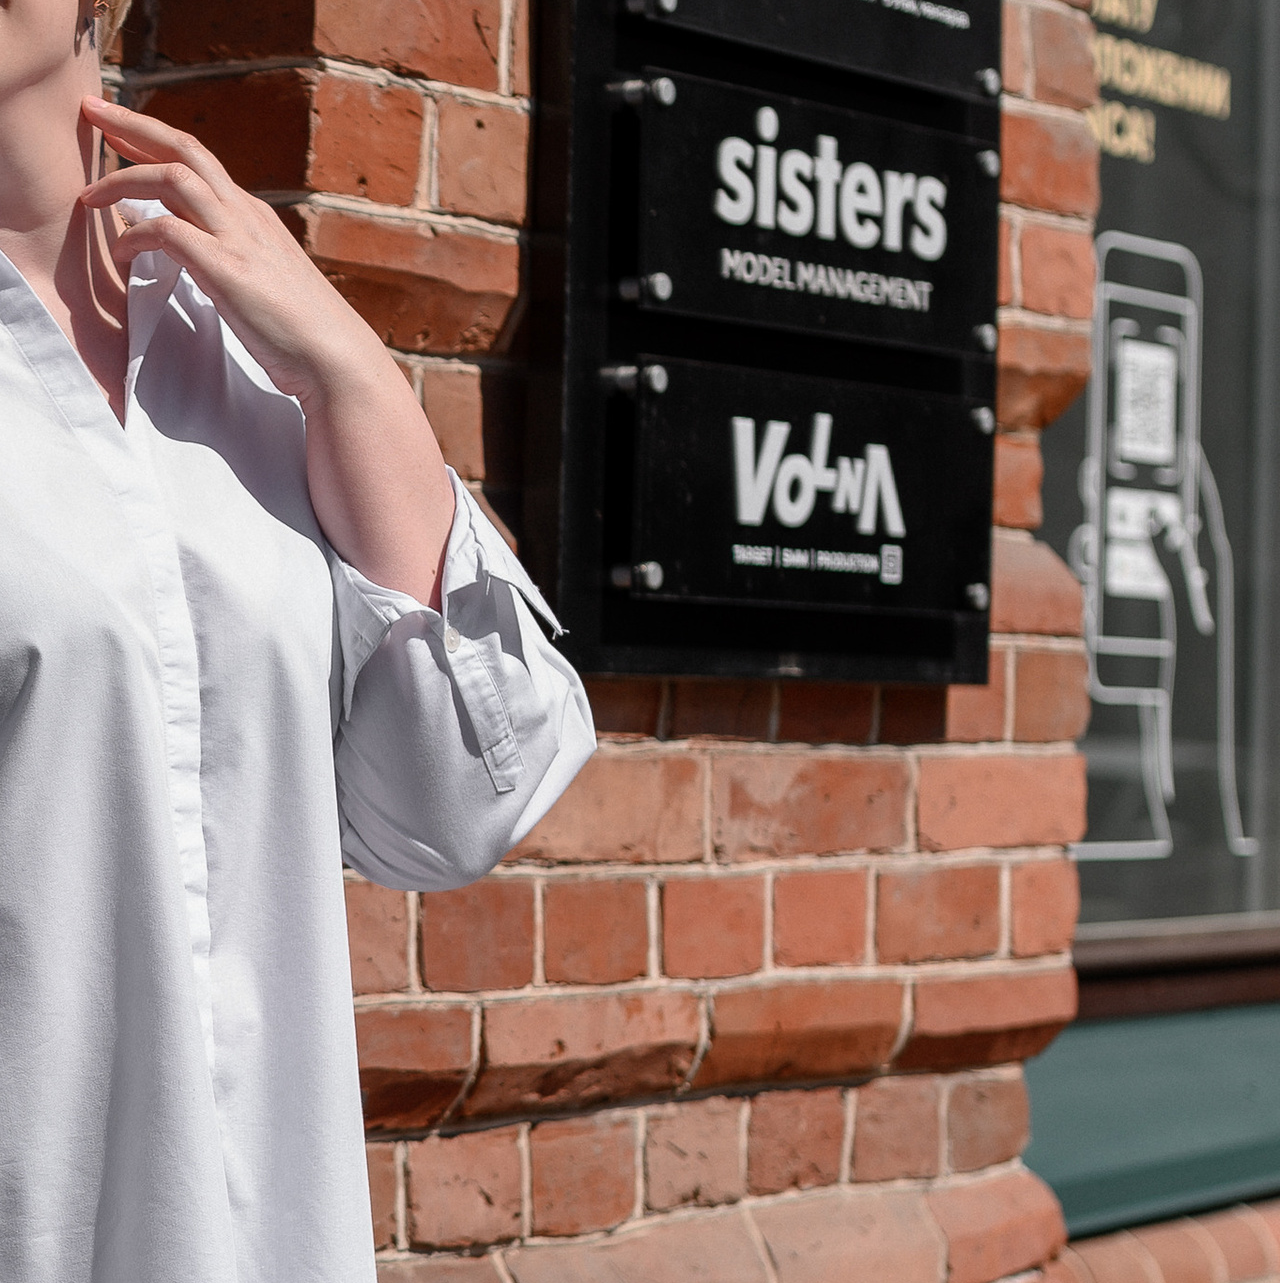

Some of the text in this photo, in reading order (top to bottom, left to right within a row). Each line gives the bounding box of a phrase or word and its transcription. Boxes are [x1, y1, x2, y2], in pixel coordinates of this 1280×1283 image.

[714, 106, 947, 262] sisters
[721, 248, 934, 313] MODEL MANAGEMENT
